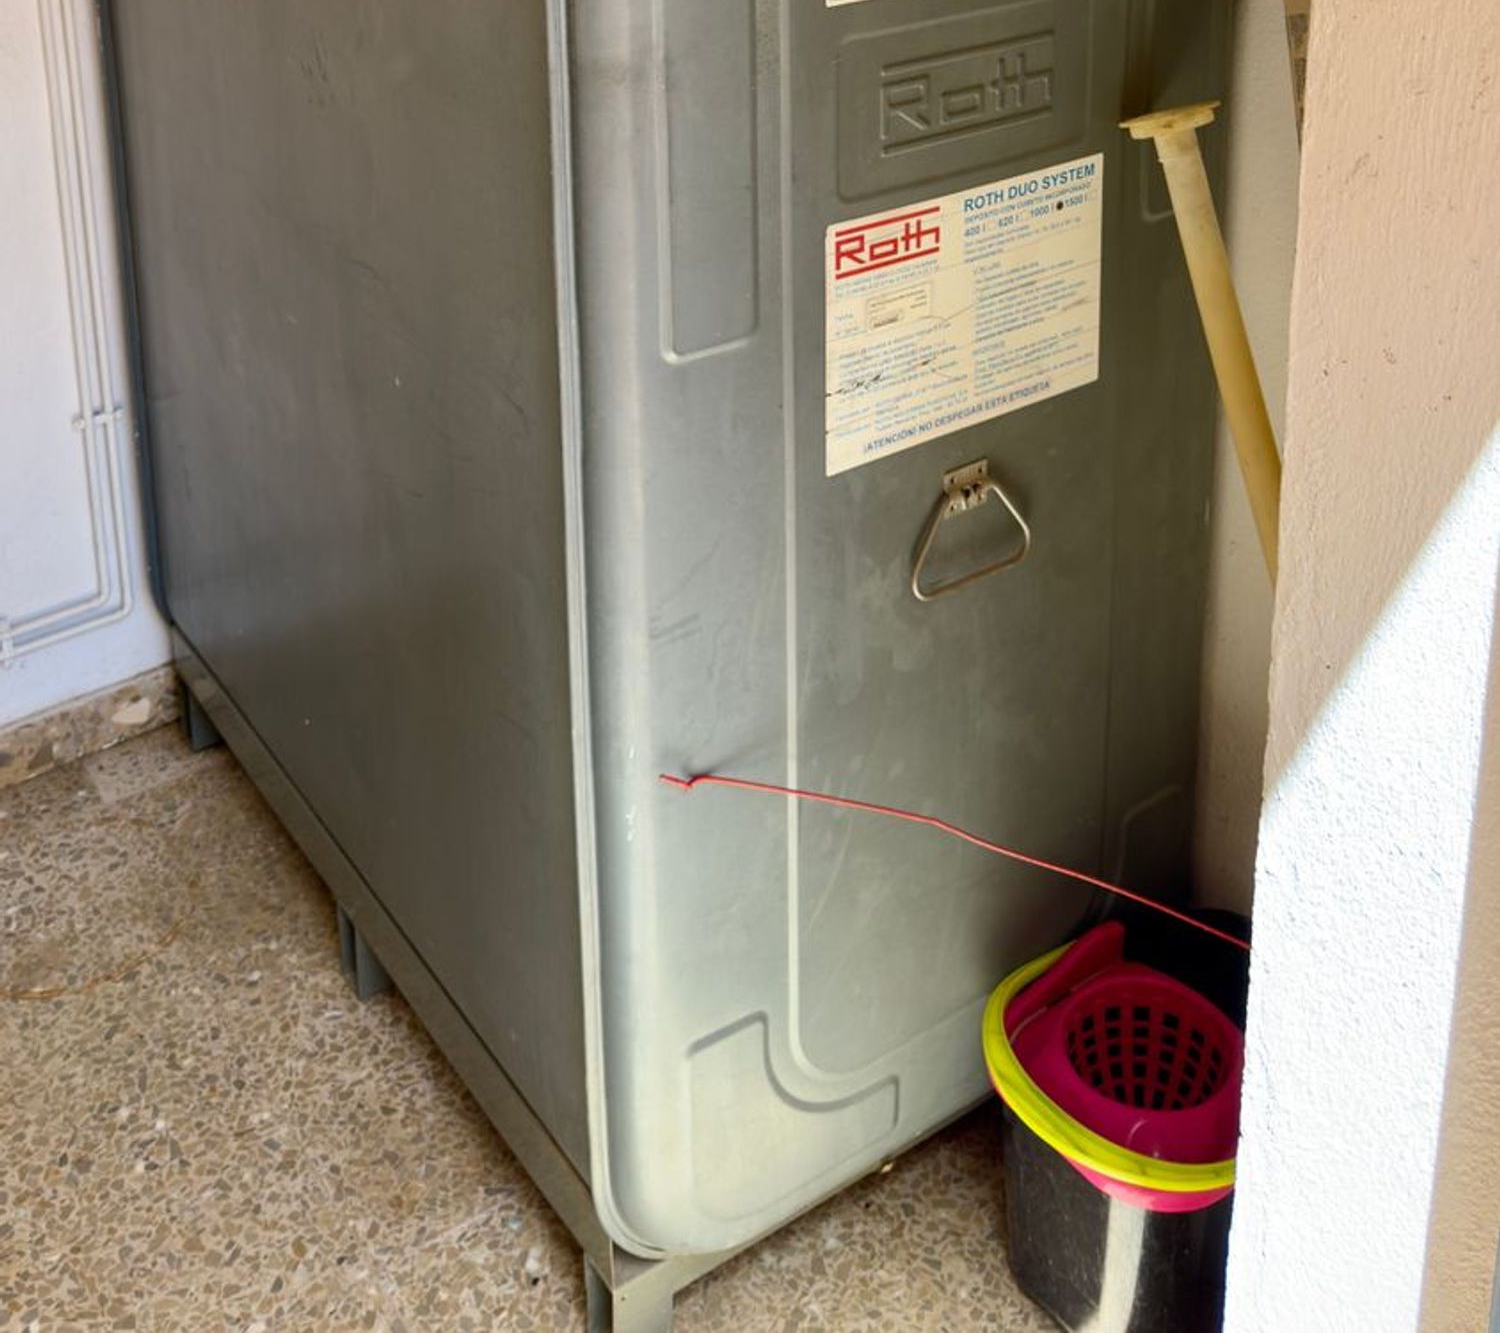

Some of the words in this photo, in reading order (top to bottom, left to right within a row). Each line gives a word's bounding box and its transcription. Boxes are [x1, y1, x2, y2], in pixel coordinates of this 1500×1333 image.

[880, 53, 1054, 140] Roth
[964, 190, 1003, 212] ROTH
[1007, 179, 1038, 199] DUO
[1041, 163, 1095, 190] SYSTEM
[835, 219, 940, 271] Roth
